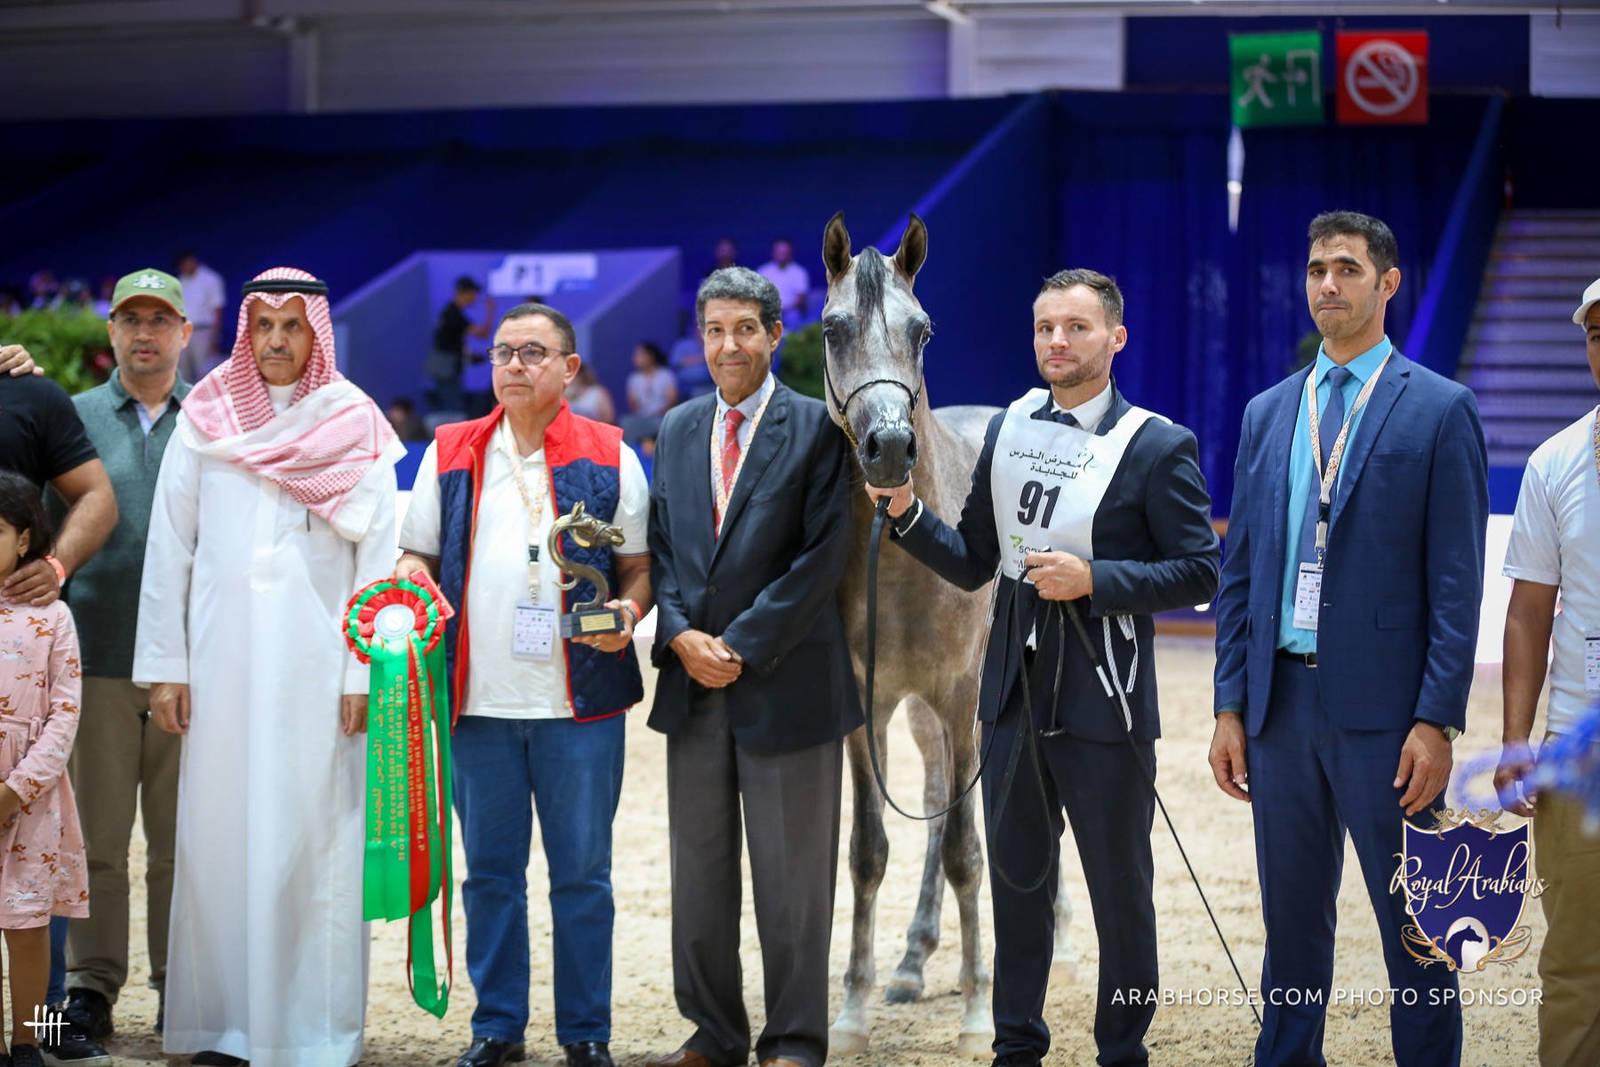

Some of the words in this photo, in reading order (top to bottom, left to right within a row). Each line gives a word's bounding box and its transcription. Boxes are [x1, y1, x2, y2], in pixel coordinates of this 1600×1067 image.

[1009, 448, 1044, 460] الفرس
[1030, 462, 1078, 480] للجديدة
[1044, 454, 1082, 468] معرض
[1017, 480, 1062, 529] 91
[387, 687, 395, 738] Arabian
[407, 680, 418, 721] Cheval
[388, 744, 396, 835] International
